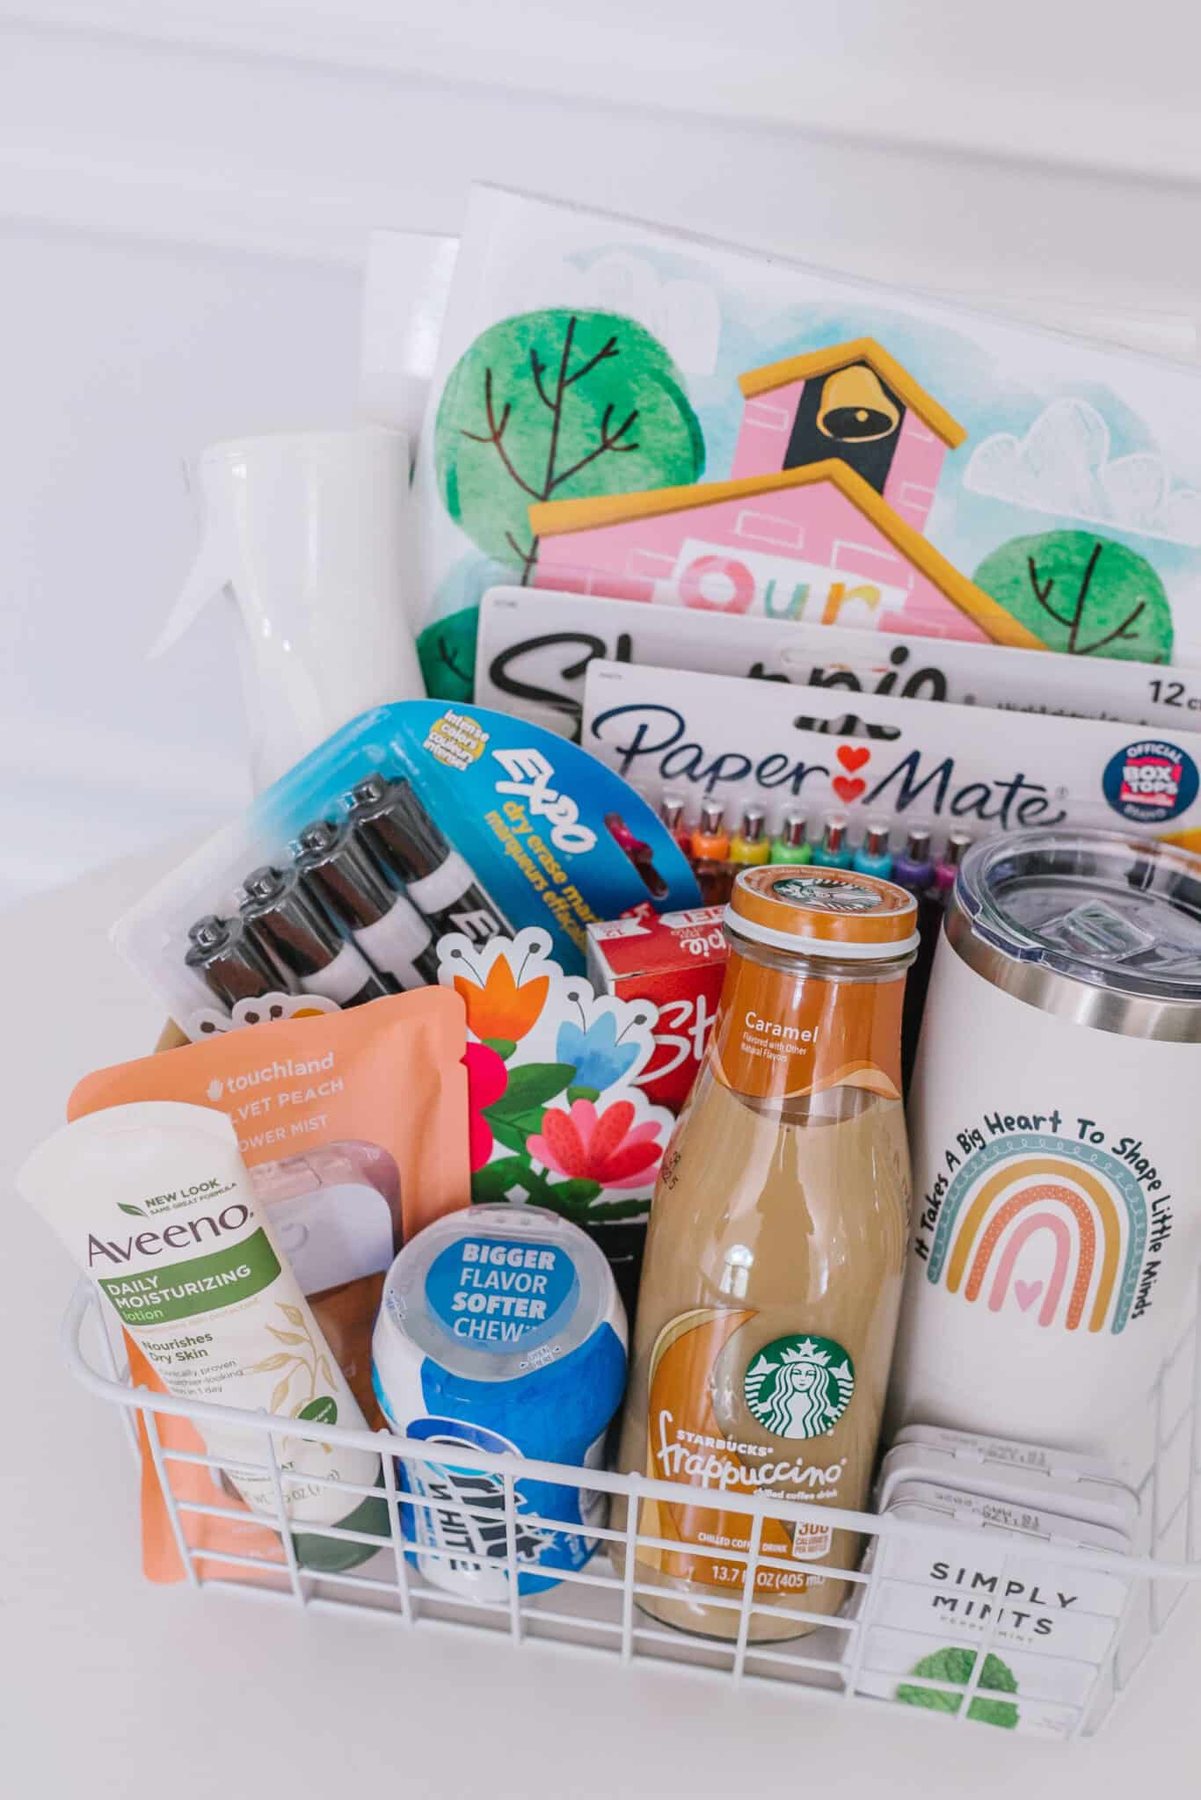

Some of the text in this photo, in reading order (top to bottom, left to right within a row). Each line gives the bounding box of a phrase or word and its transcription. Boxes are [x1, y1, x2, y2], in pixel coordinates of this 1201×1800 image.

[1149, 680, 1201, 710] 12 c
[591, 703, 1067, 831] Paper Mate
[1126, 742, 1182, 764] OFFICIAL
[1123, 765, 1171, 782] BOX
[1129, 780, 1178, 795] TOPS
[484, 810, 548, 891] marqueurs
[503, 801, 533, 834] dry
[527, 835, 567, 884] erase
[745, 1011, 819, 1043] Caramel
[226, 1051, 335, 1094] touchland
[277, 1077, 344, 1108] PEACH
[290, 1113, 328, 1136] MIST
[145, 1178, 220, 1208] NEW LOOK
[150, 1206, 171, 1215] SAME
[172, 1198, 198, 1209] GREAT
[914, 1110, 1174, 1320] It Takes A Big Heart To Shape Little Minds
[87, 1204, 249, 1267] Aveeno
[462, 1243, 556, 1271] BIGGER
[107, 1276, 159, 1296] DAILY
[115, 1264, 251, 1309] MOISTURIZING
[460, 1268, 547, 1294] FLAVOR
[122, 1308, 164, 1322] lotion
[451, 1291, 547, 1319] SOFTER
[142, 1333, 213, 1351] Nourishes
[149, 1348, 208, 1364] Dry Skin
[676, 1430, 767, 1457] STARBUCKS
[785, 1491, 815, 1500] coffee
[816, 1488, 837, 1499] drink
[698, 1532, 730, 1546] CHILLED
[762, 1543, 788, 1552] DRINK
[712, 1565, 740, 1582] 13.7
[756, 1572, 774, 1586] OZ
[775, 1572, 804, 1589] (405
[930, 1562, 1079, 1609] SIMPLY
[932, 1595, 1054, 1635] MINTS
